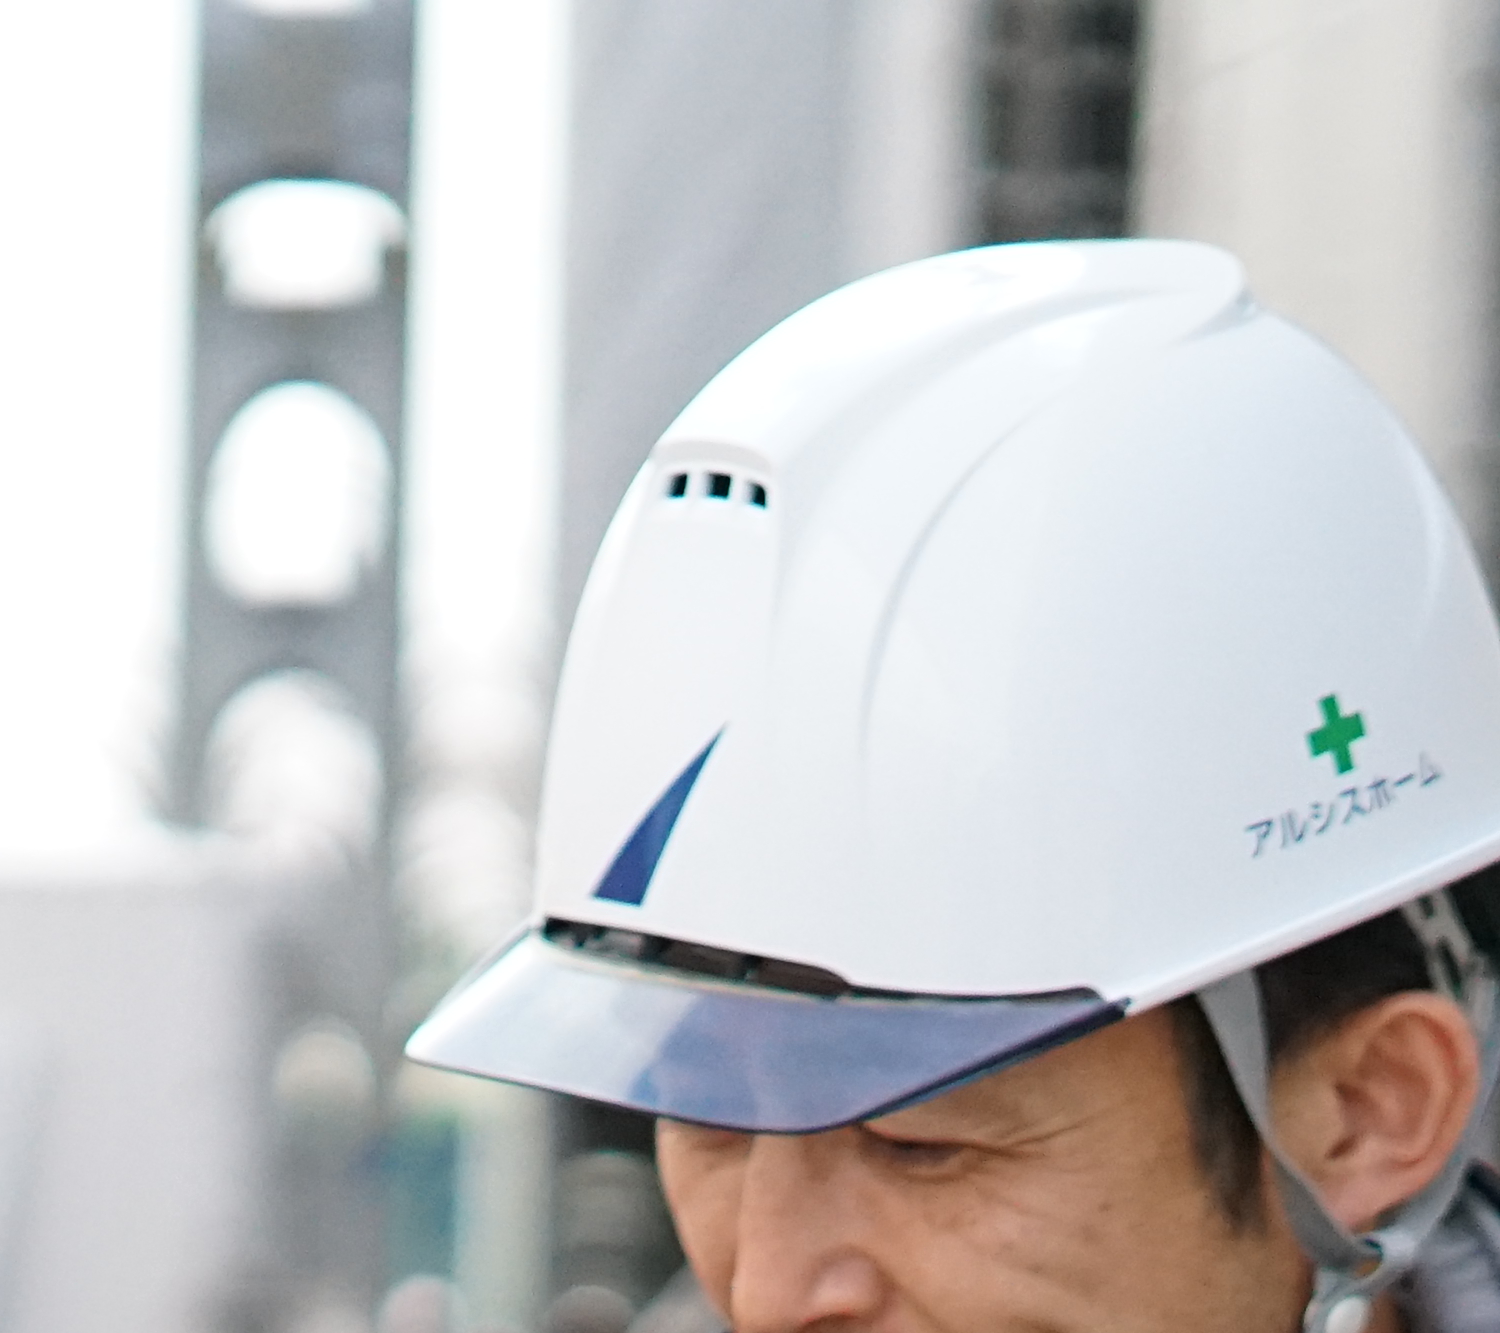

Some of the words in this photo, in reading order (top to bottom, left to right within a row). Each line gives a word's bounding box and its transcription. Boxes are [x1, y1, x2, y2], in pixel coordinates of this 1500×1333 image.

[1244, 752, 1443, 858] アルシスホーム
